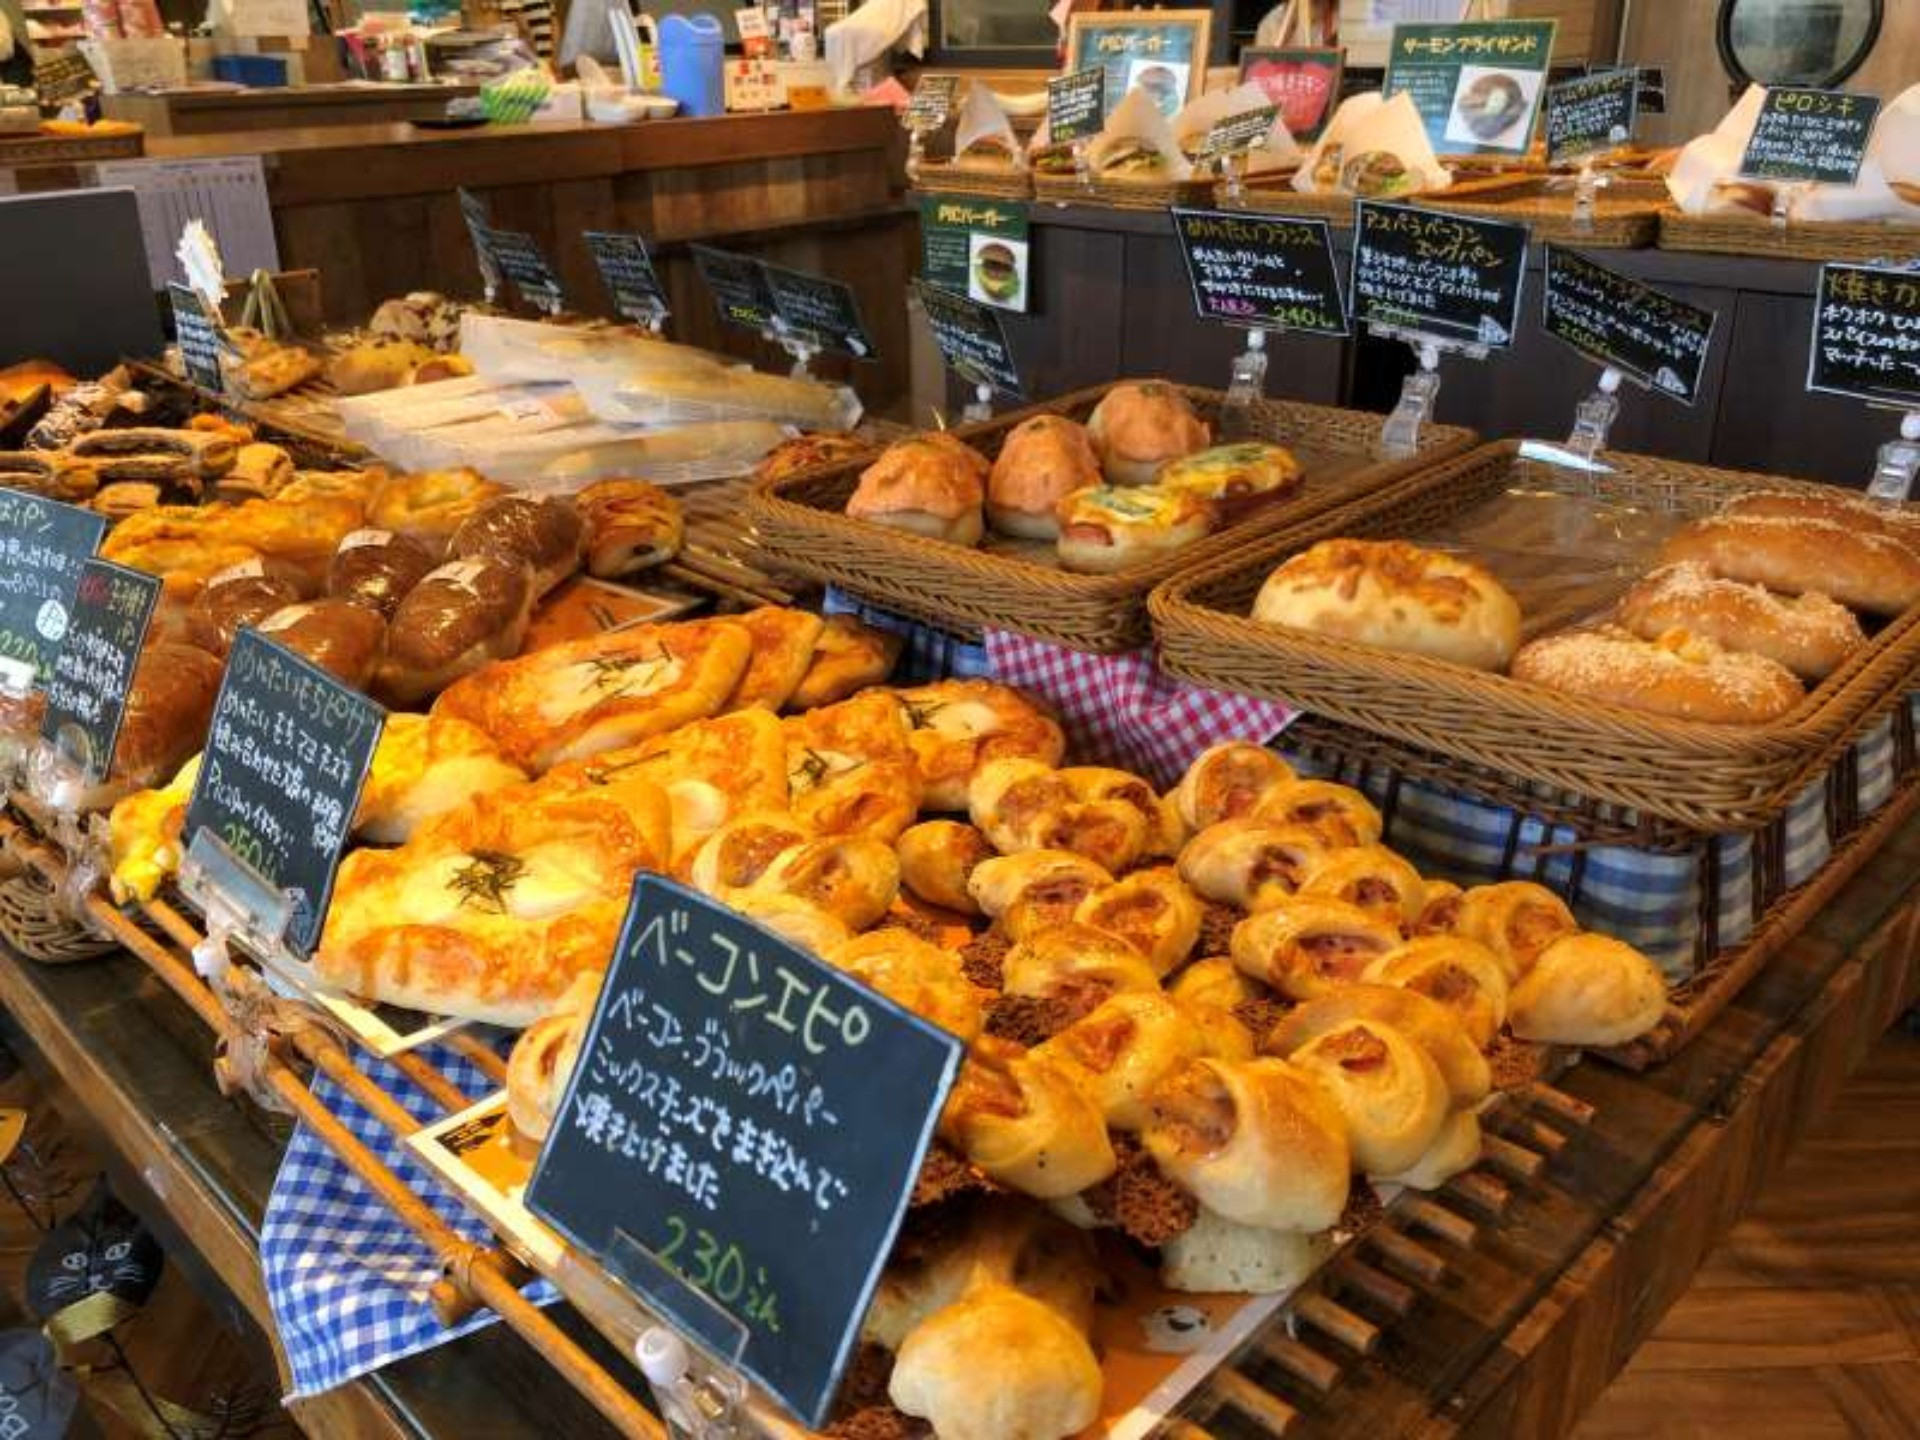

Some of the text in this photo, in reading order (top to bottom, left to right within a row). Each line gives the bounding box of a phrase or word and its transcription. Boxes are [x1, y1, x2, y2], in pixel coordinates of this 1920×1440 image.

[1403, 36, 1537, 55] サーモンフライサンド
[1775, 92, 1855, 117] ピロシキ
[1363, 209, 1482, 244] アスパラベーコン
[1416, 240, 1503, 267] エッグパン
[631, 911, 870, 1055] ベーコンエピ
